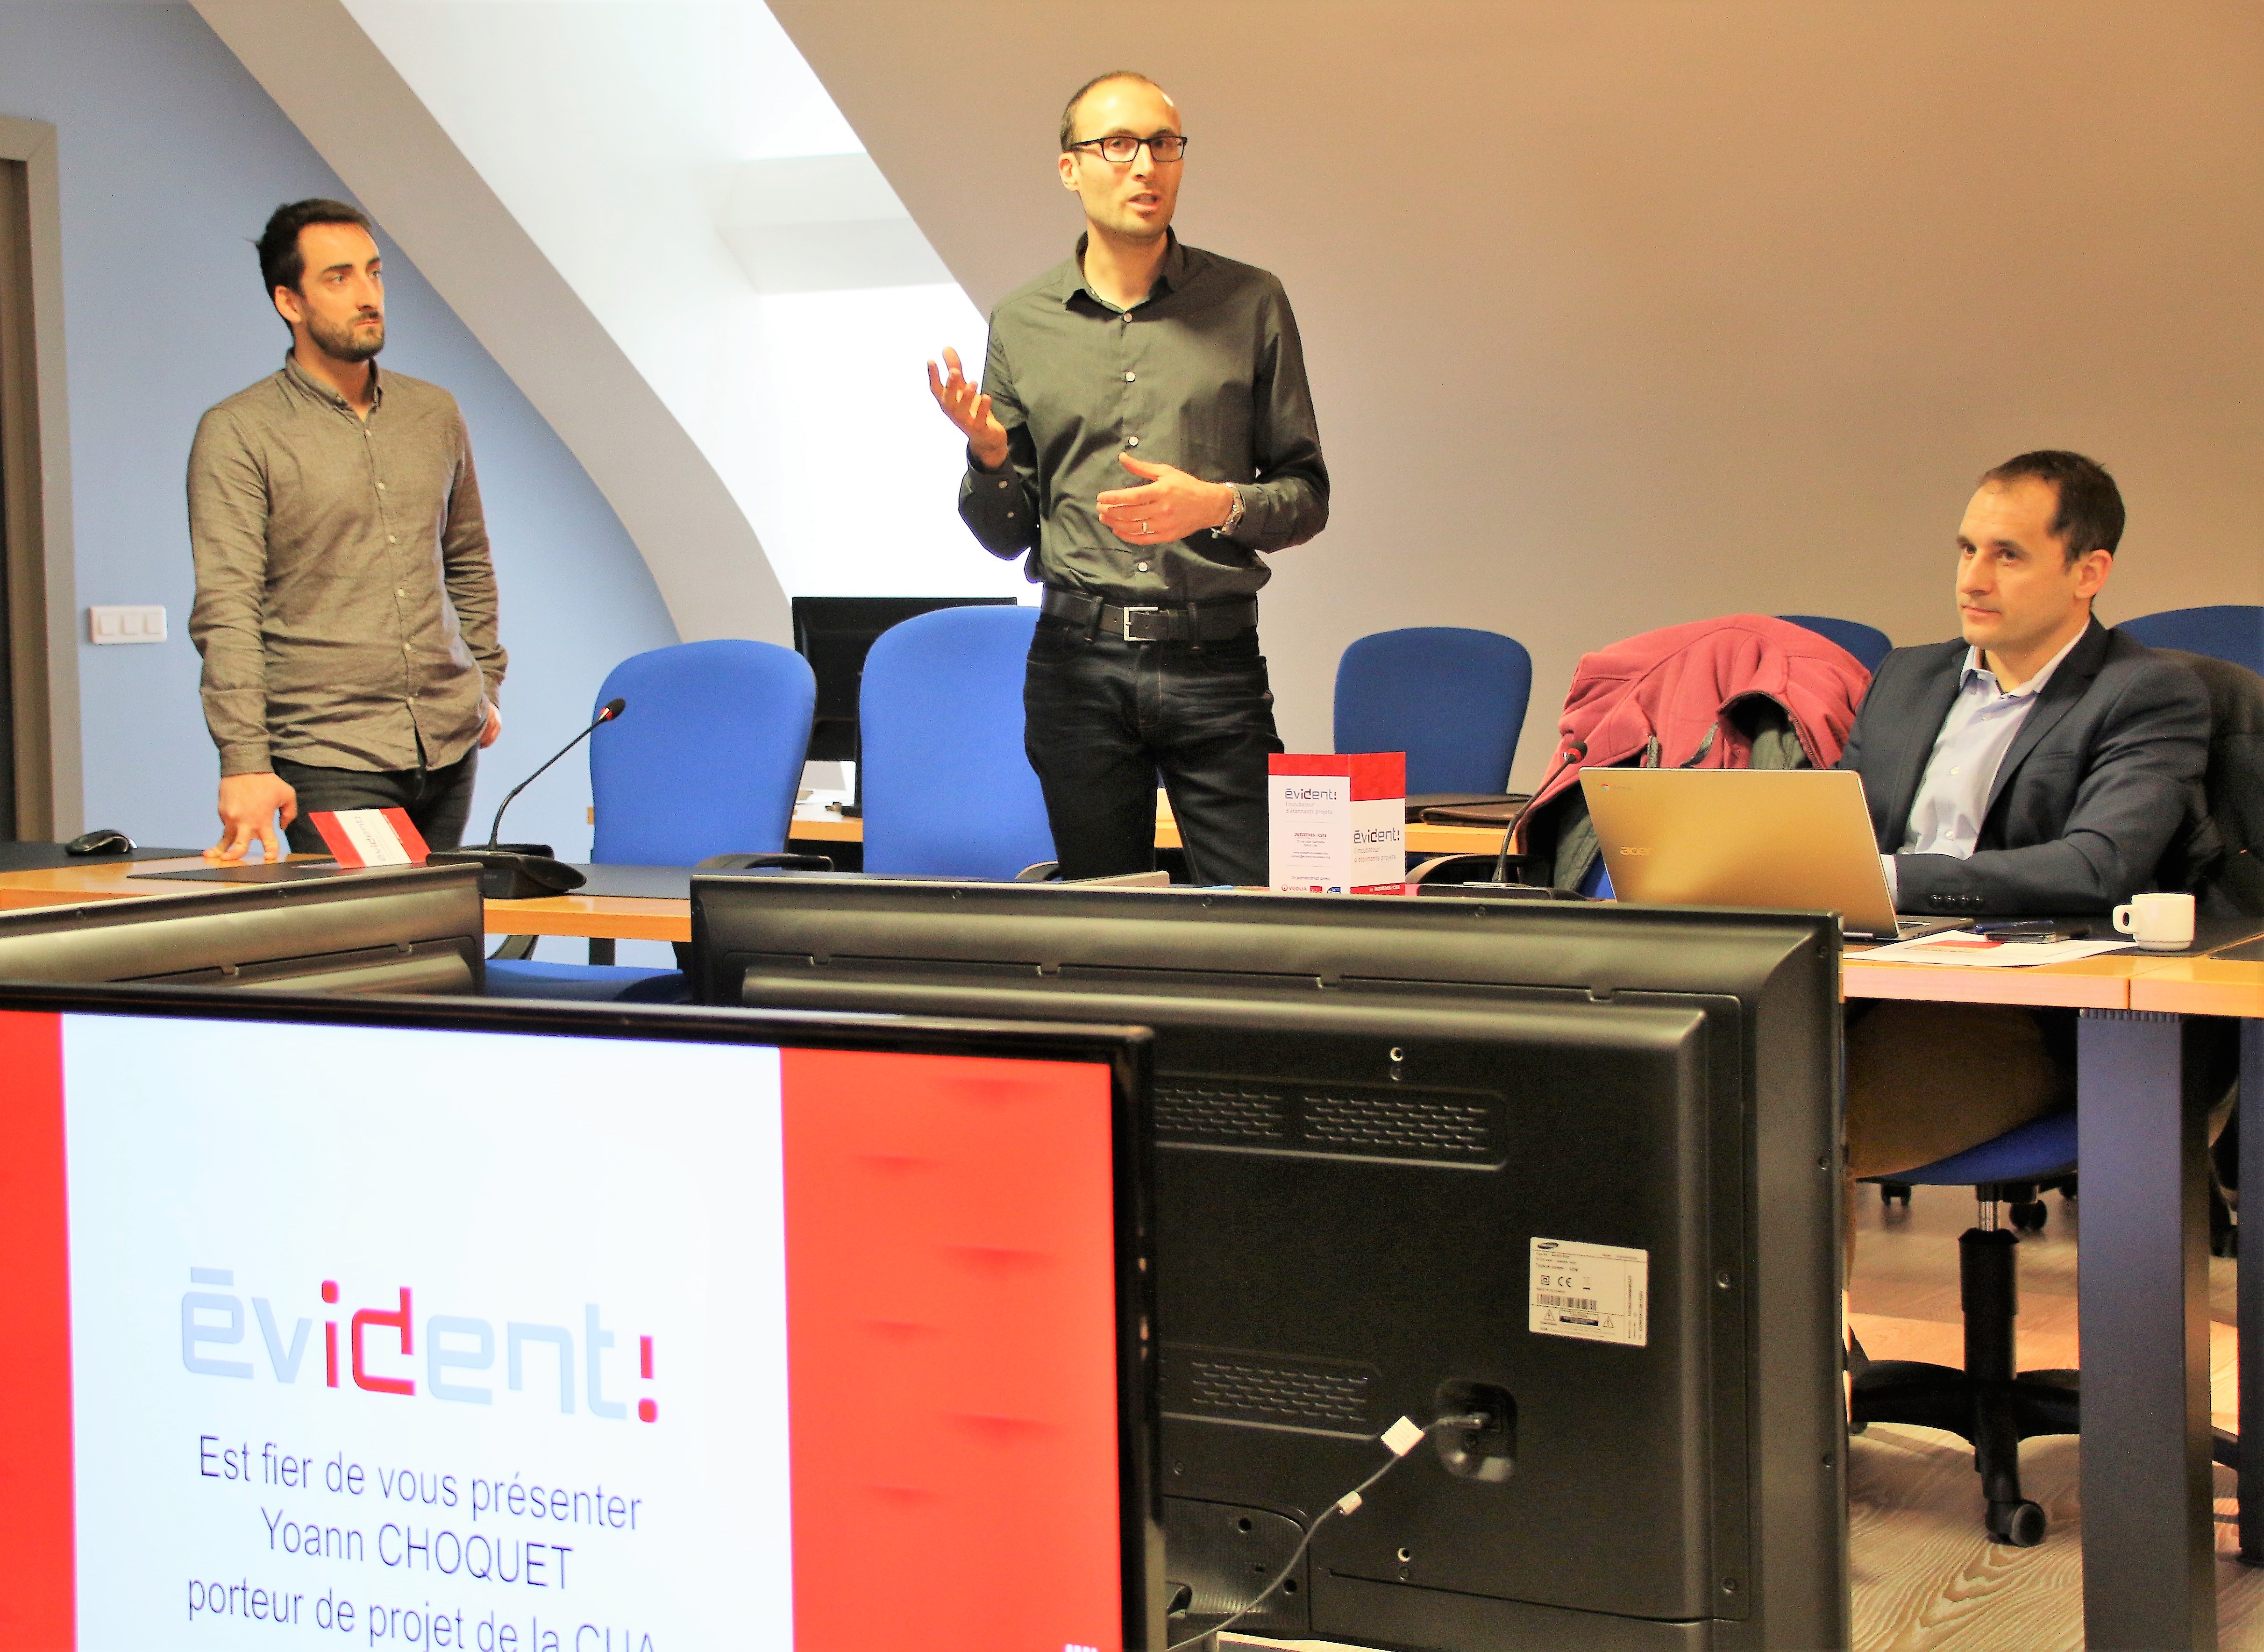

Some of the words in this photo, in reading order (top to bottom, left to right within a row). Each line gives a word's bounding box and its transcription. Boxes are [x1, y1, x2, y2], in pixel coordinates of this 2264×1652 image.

[200, 1434, 251, 1482] Est
[262, 1441, 313, 1488] fier
[326, 1451, 365, 1496] de
[378, 1467, 458, 1508] vous
[471, 1472, 642, 1531] présenter
[261, 1506, 363, 1562] Yoann
[378, 1523, 574, 1590] CHOQUET
[188, 1577, 304, 1624] porteur
[316, 1587, 355, 1633] de
[369, 1601, 464, 1652] projet
[477, 1610, 518, 1652] de
[533, 1616, 559, 1652] la
